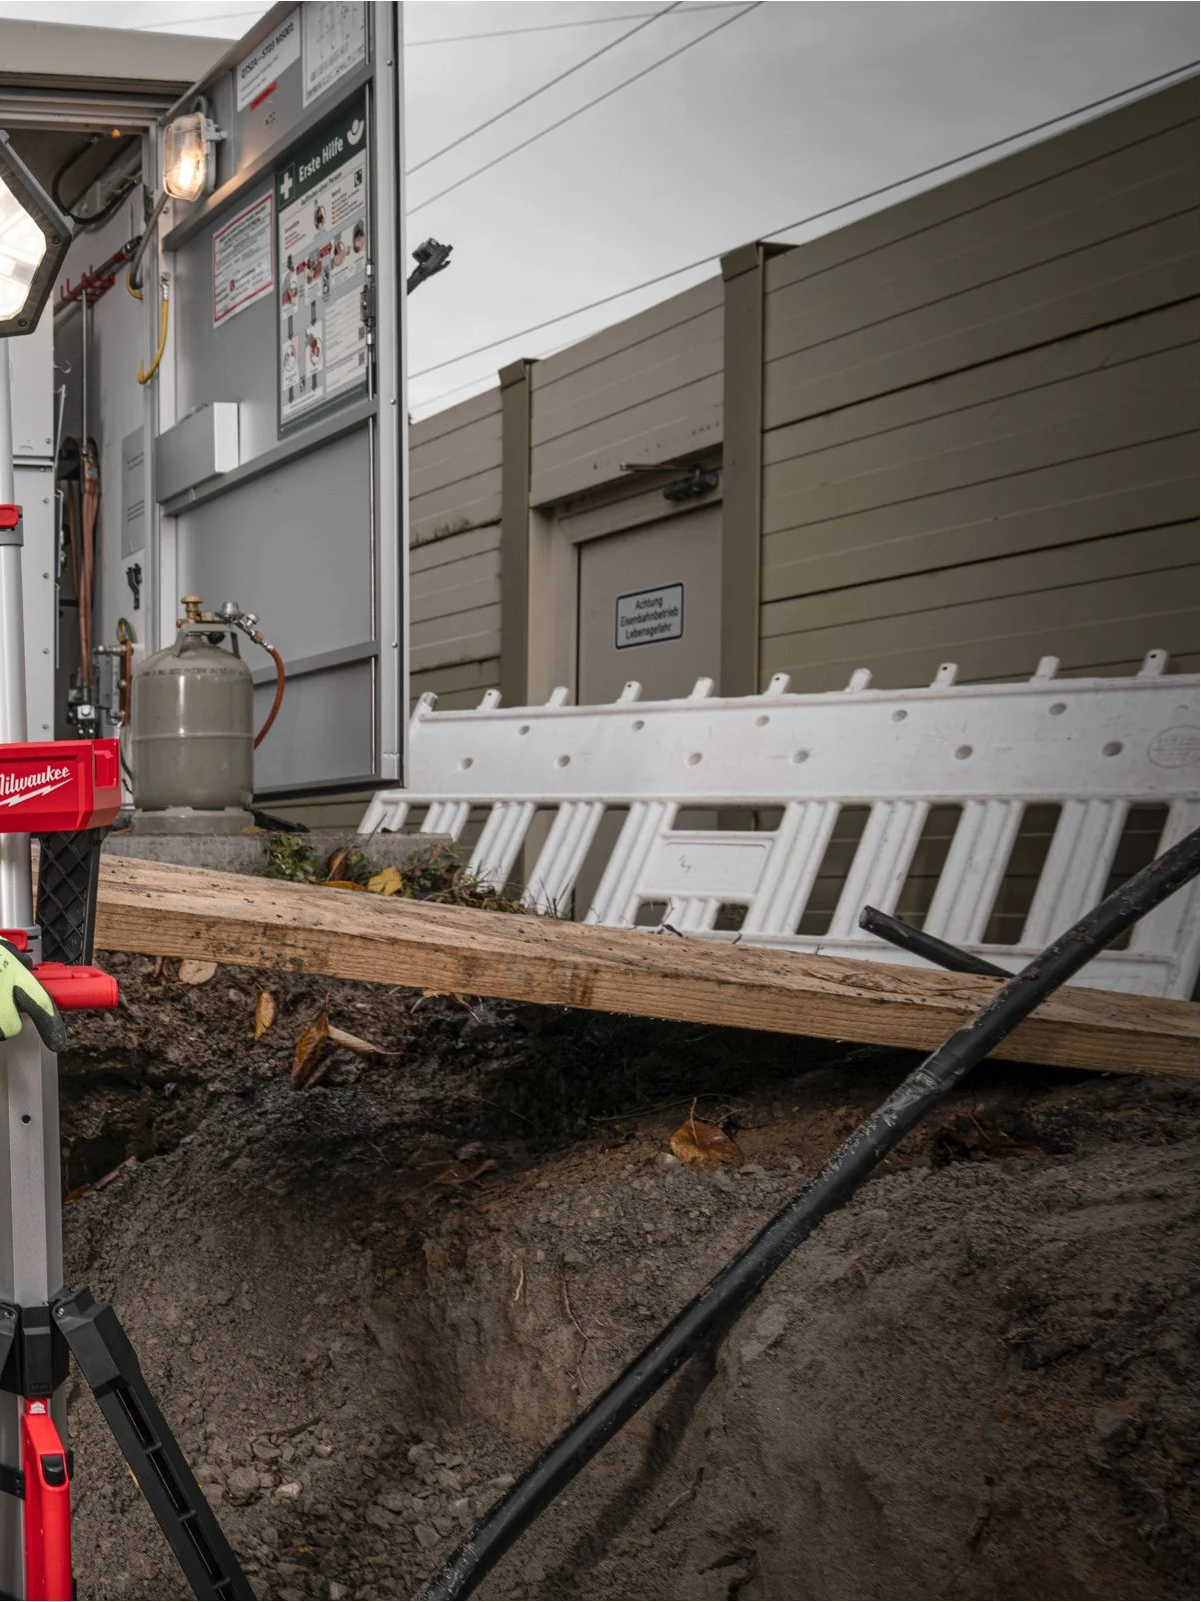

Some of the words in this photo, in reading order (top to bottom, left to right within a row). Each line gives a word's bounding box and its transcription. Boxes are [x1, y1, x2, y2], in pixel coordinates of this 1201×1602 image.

[299, 156, 322, 183] Erste
[322, 137, 344, 164] Hilfe
[635, 597, 663, 609] Achtung
